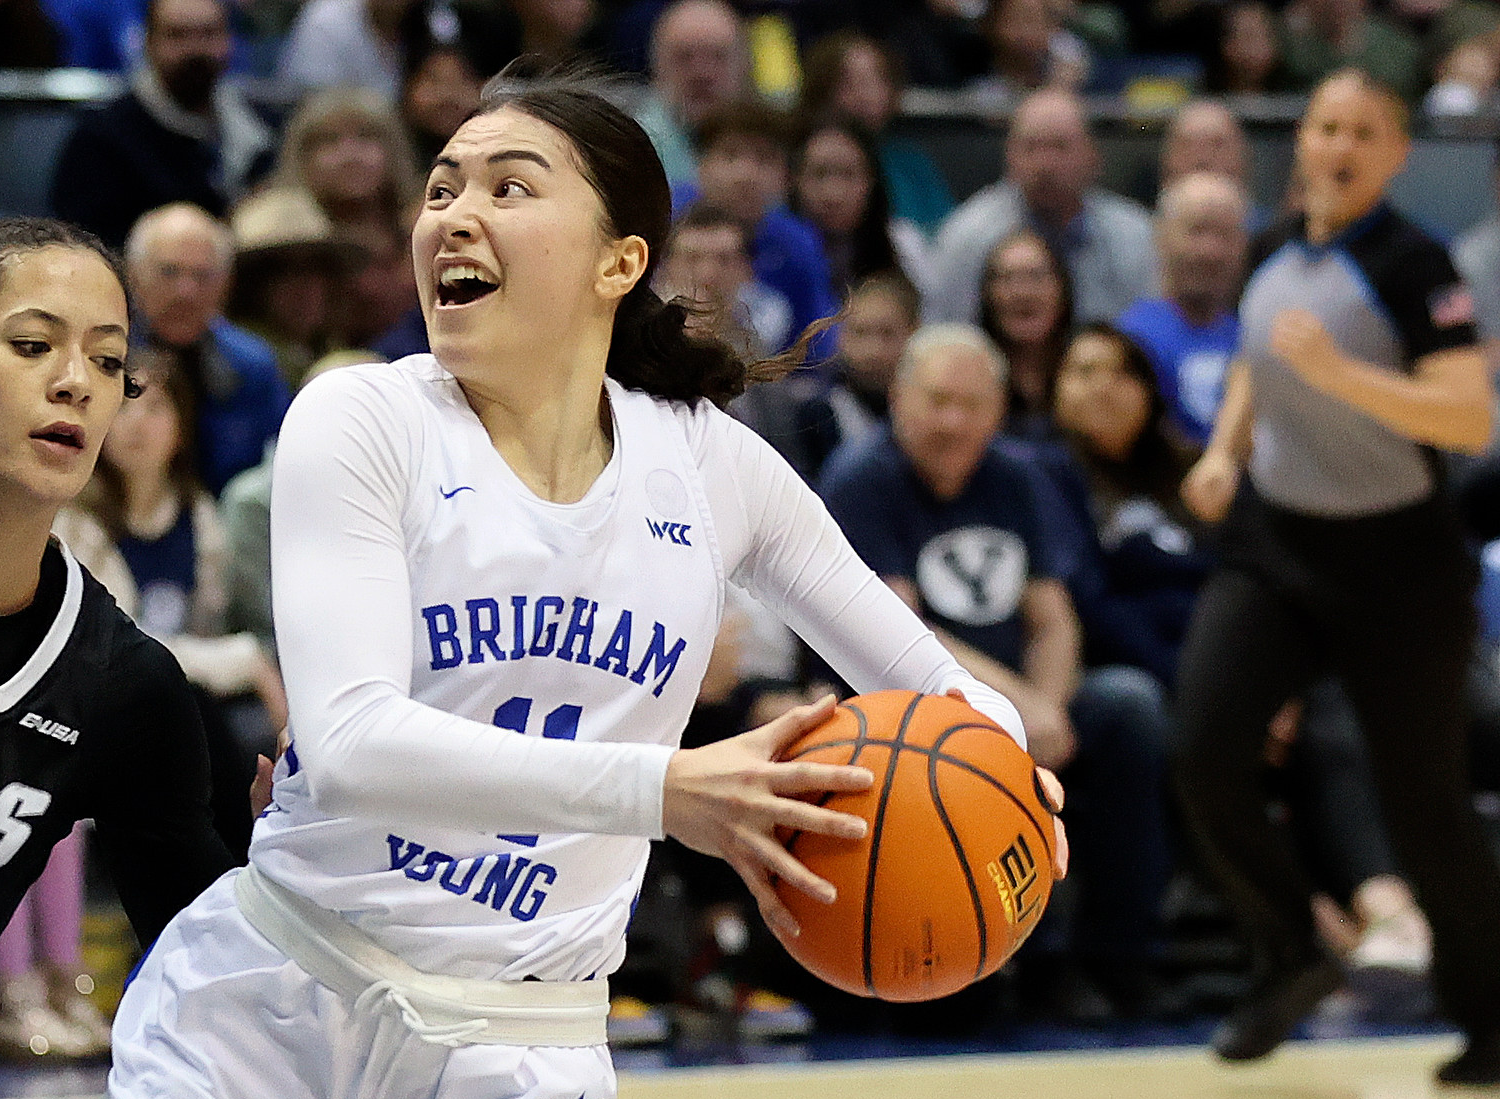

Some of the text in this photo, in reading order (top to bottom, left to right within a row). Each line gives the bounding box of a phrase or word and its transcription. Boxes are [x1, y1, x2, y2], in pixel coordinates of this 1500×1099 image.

[644, 516, 692, 547] WCC
[421, 595, 687, 699] BRIGHAM
[385, 833, 558, 922] YOUNG
